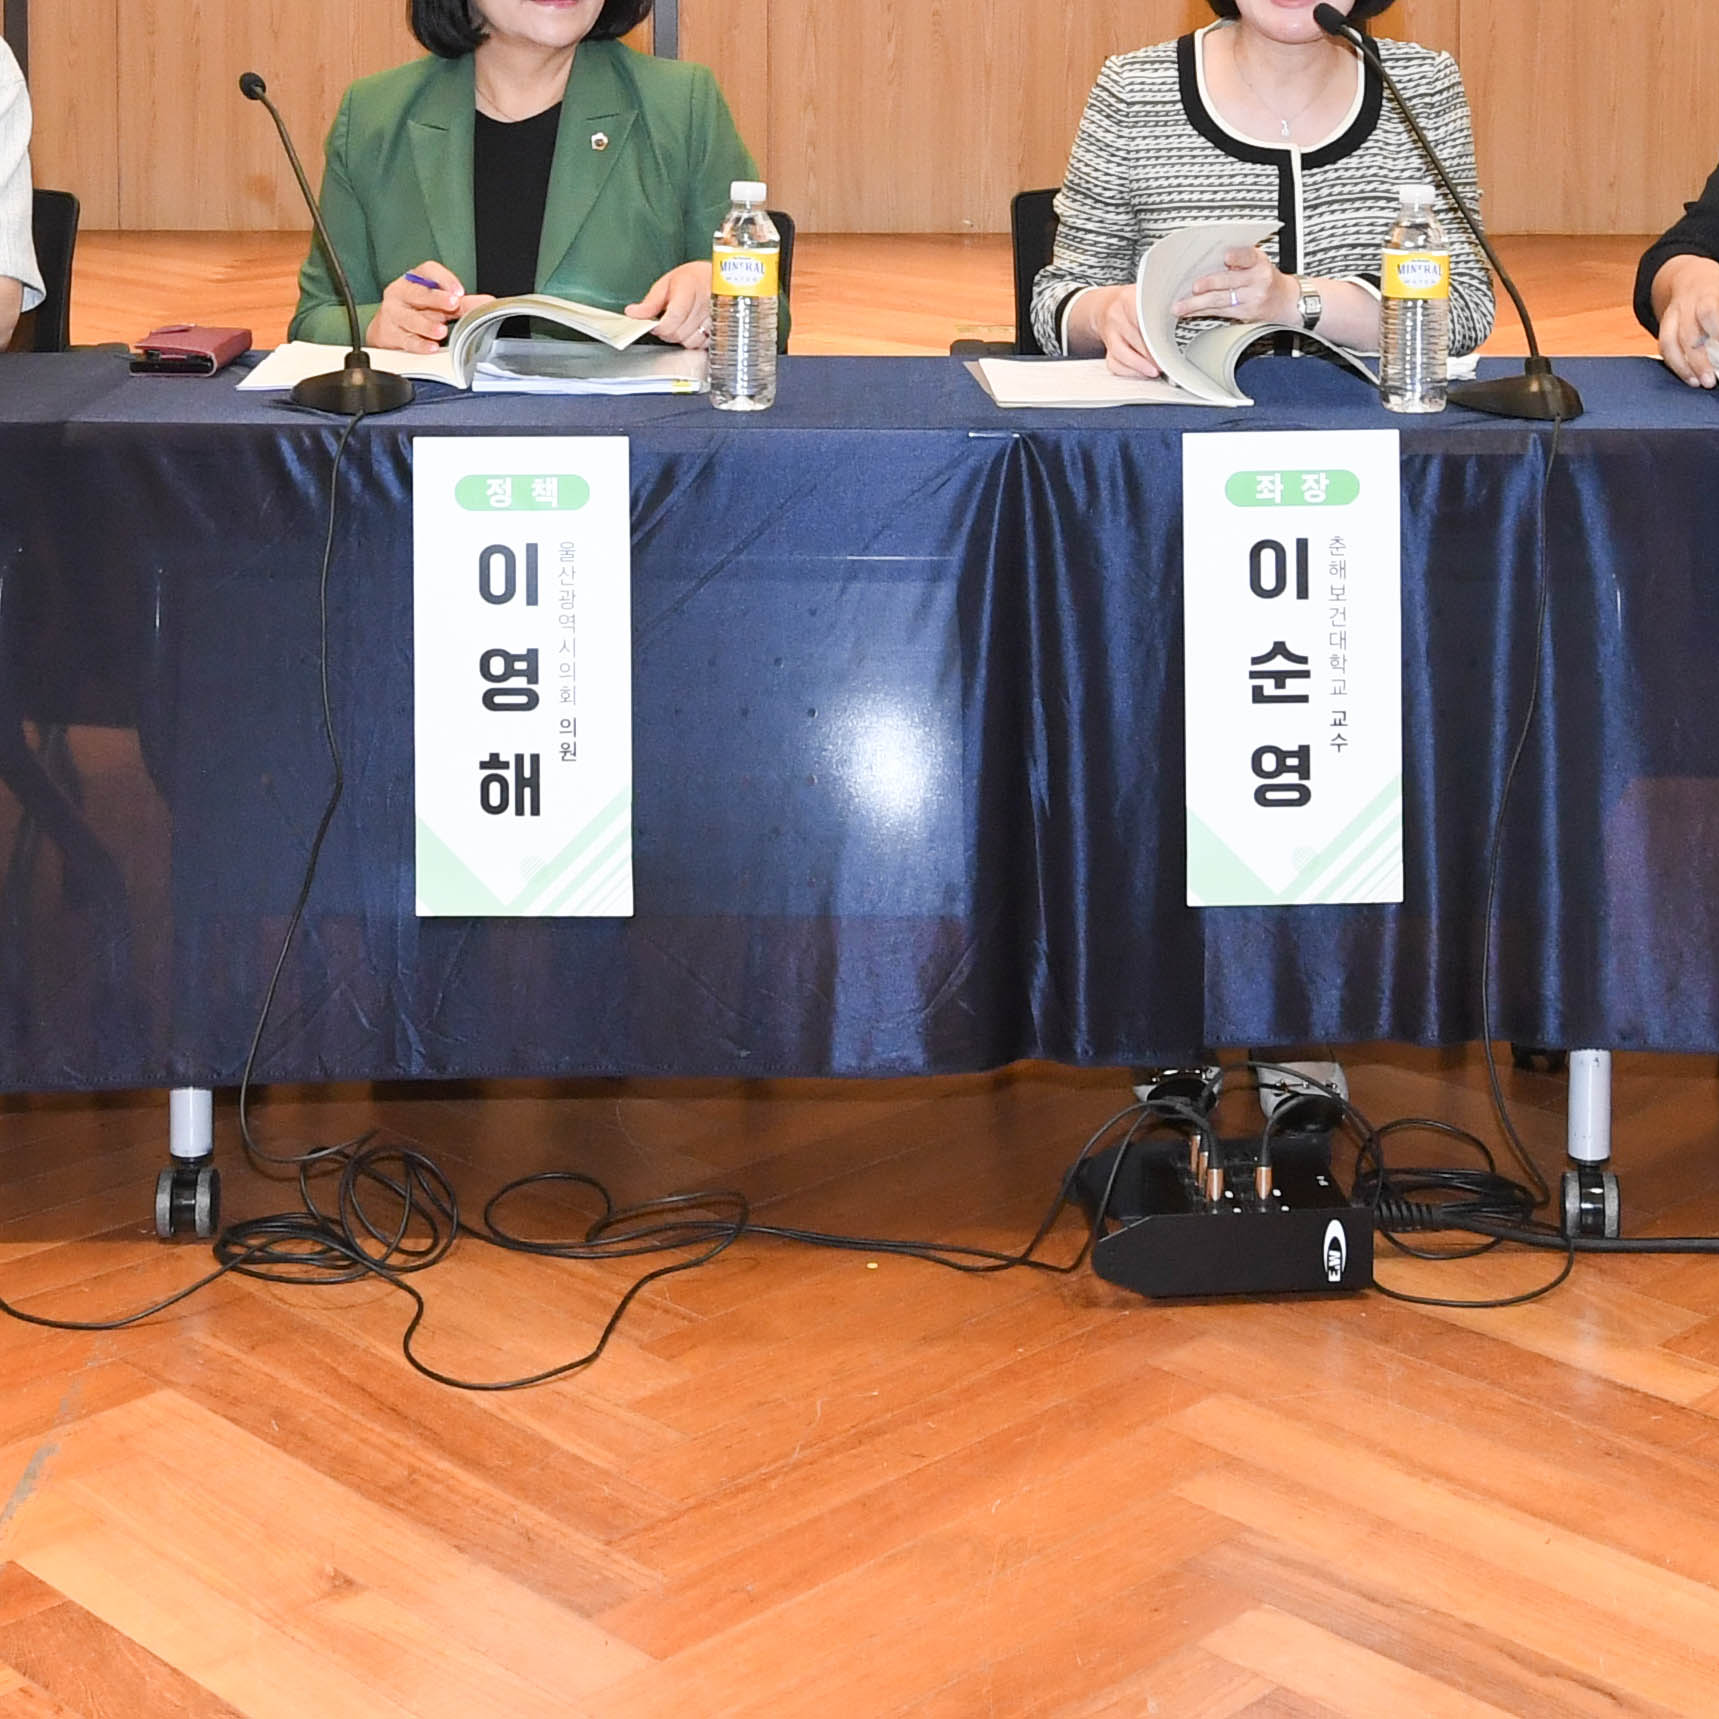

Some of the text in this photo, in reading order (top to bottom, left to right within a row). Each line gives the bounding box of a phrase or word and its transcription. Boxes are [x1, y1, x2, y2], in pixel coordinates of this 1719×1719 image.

[478, 543, 543, 818] 이영해
[557, 540, 578, 763] 울산광역시의회 의원
[1247, 537, 1313, 809] 이순영
[1327, 534, 1349, 754] 춘해보건대학교 교수
